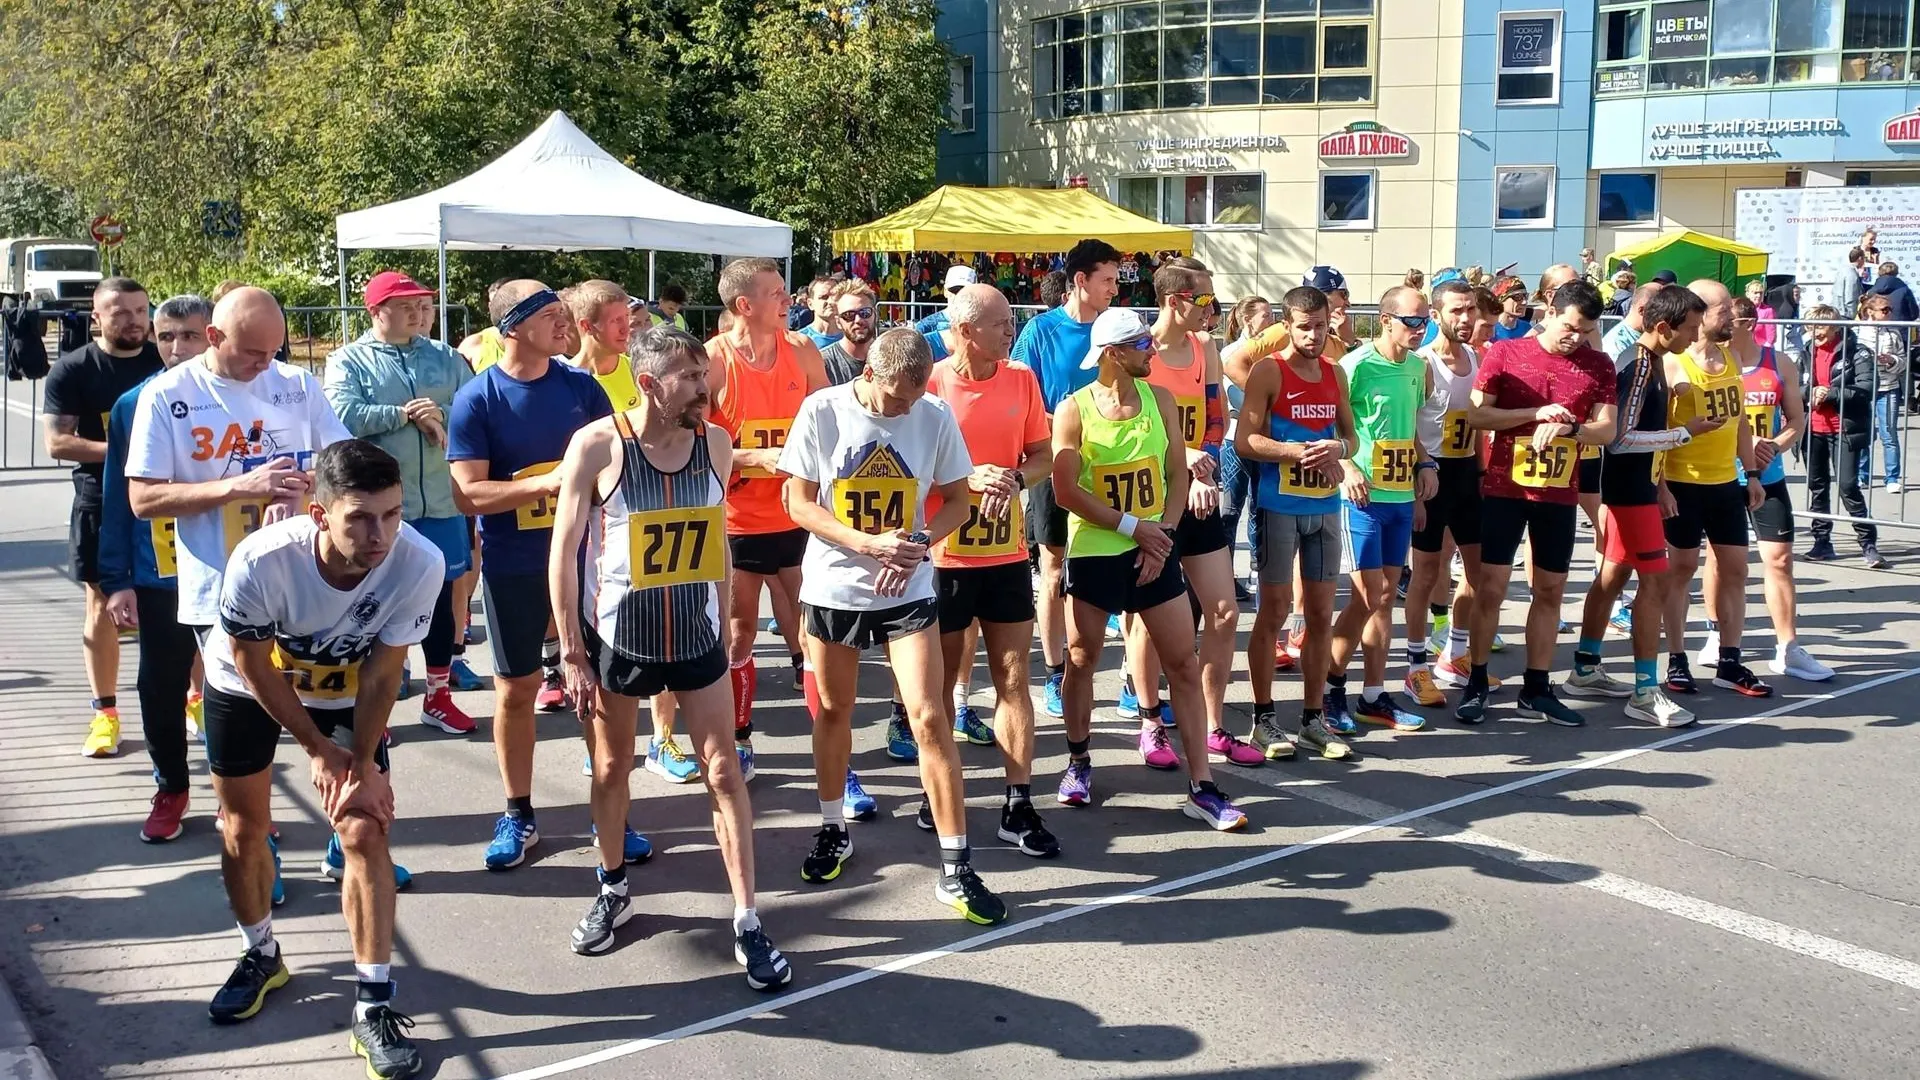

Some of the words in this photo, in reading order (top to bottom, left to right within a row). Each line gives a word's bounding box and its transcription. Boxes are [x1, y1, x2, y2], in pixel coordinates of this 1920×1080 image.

[1655, 15, 1708, 34] ЦВЕТЫ
[1513, 34, 1543, 50] 737
[1672, 33, 1708, 43] ПУЧКОМ
[1512, 51, 1543, 60] LOUNGE
[1612, 71, 1639, 81] ЦВЕТЫ
[1651, 122, 1704, 136] ЛУЧШЕ
[1135, 138, 1175, 152] ЛУЧШЕ
[1320, 135, 1356, 156] ПАПА
[1358, 133, 1408, 156] ДЖОНС
[1650, 143, 1703, 157] ЛУЧШЕ
[1134, 157, 1175, 170] ЛУЧШЕ
[1704, 385, 1741, 421] 338
[1291, 404, 1337, 419] RUSSIA
[871, 463, 889, 471] RUN
[1523, 444, 1569, 479] 356
[1103, 467, 1155, 513] 378
[845, 490, 905, 535] 354
[958, 504, 1012, 547] 258
[643, 520, 709, 576] 277
